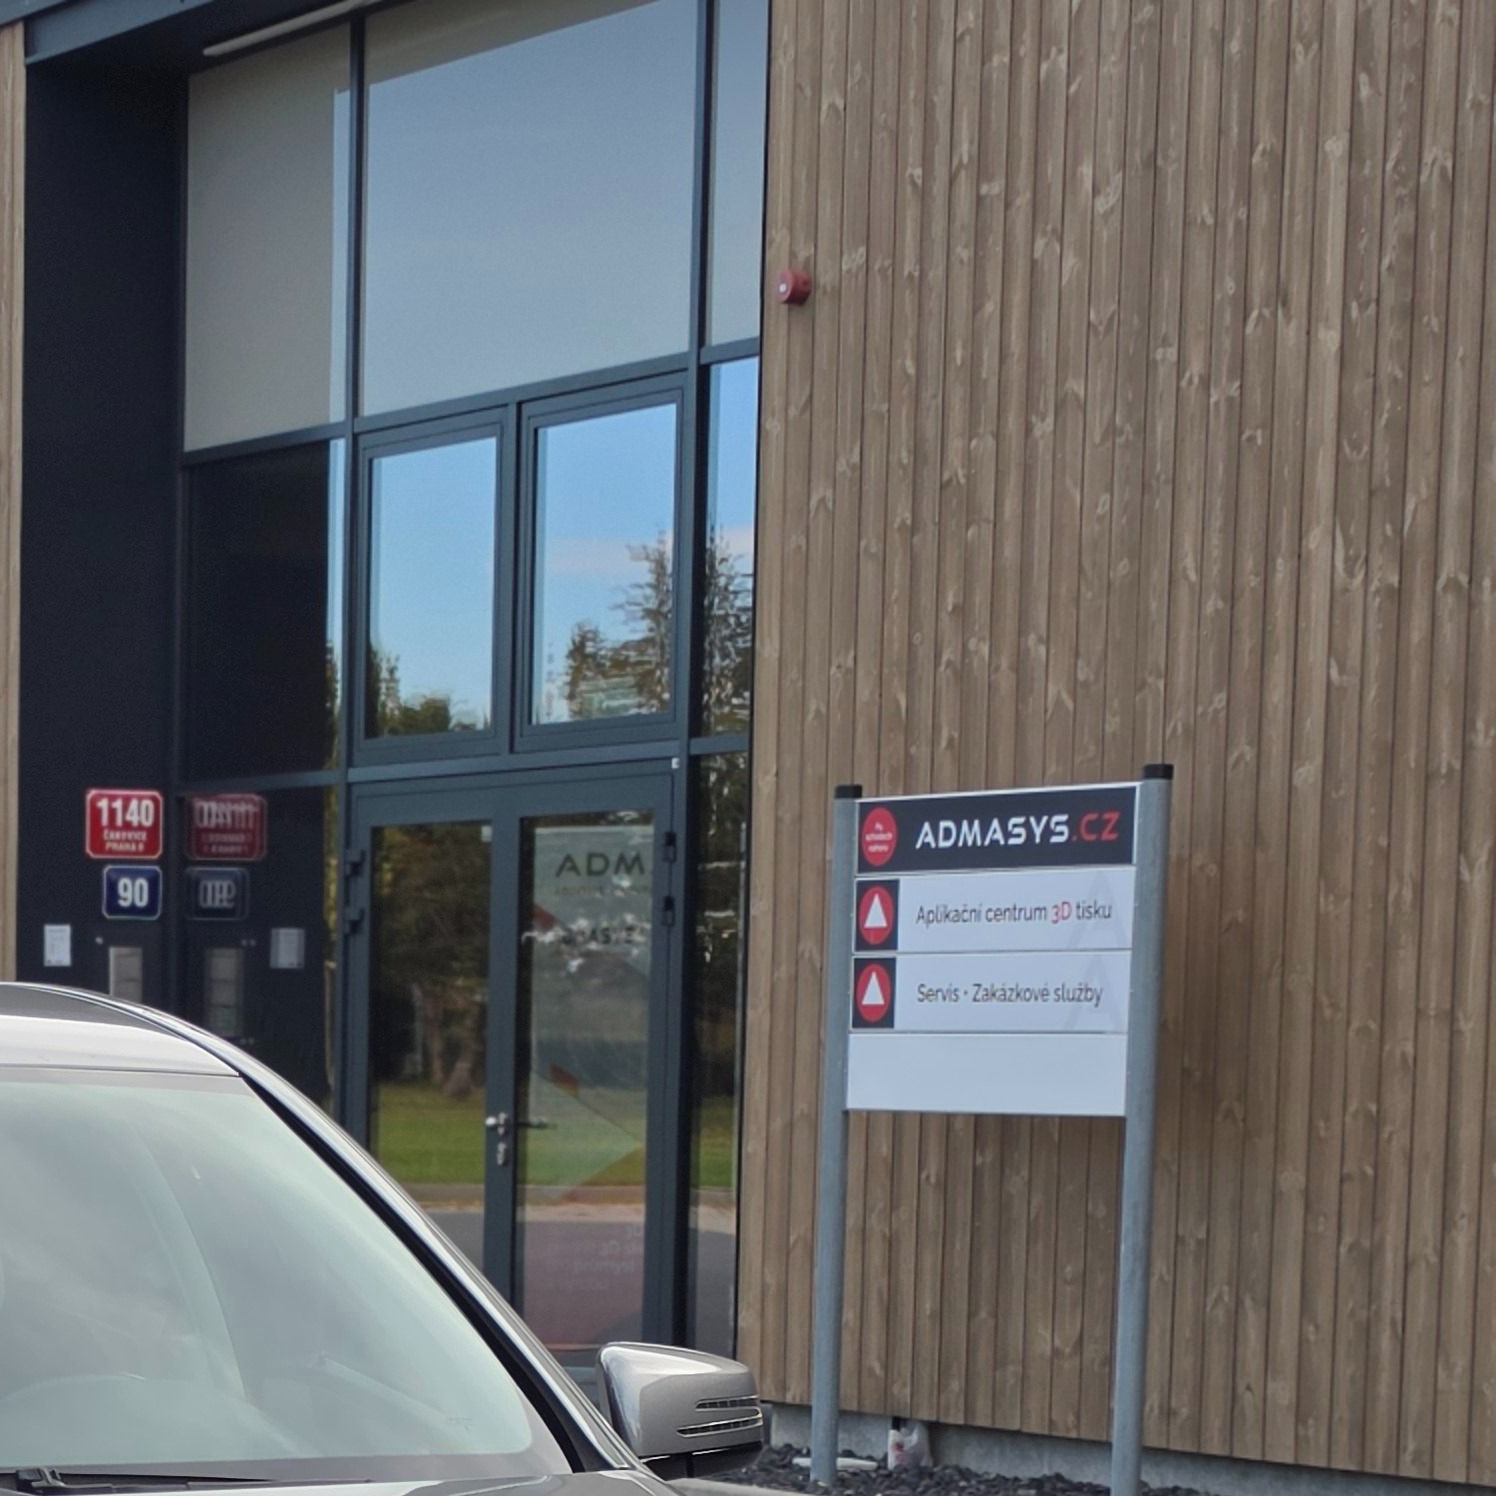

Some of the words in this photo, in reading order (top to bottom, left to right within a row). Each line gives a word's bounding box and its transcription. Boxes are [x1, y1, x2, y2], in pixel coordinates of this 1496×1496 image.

[96, 797, 155, 828] 1140
[915, 811, 1120, 849] ADMASYS.CZ
[555, 852, 645, 877] ADM
[117, 877, 150, 908] 90
[915, 902, 982, 930] Aplikační
[985, 903, 1047, 923] centrum
[1051, 900, 1072, 925] 3D
[1076, 900, 1112, 920] tisku
[917, 982, 960, 1003] Servis
[972, 982, 1050, 1003] Zakázkové
[1053, 981, 1104, 1008] služby
